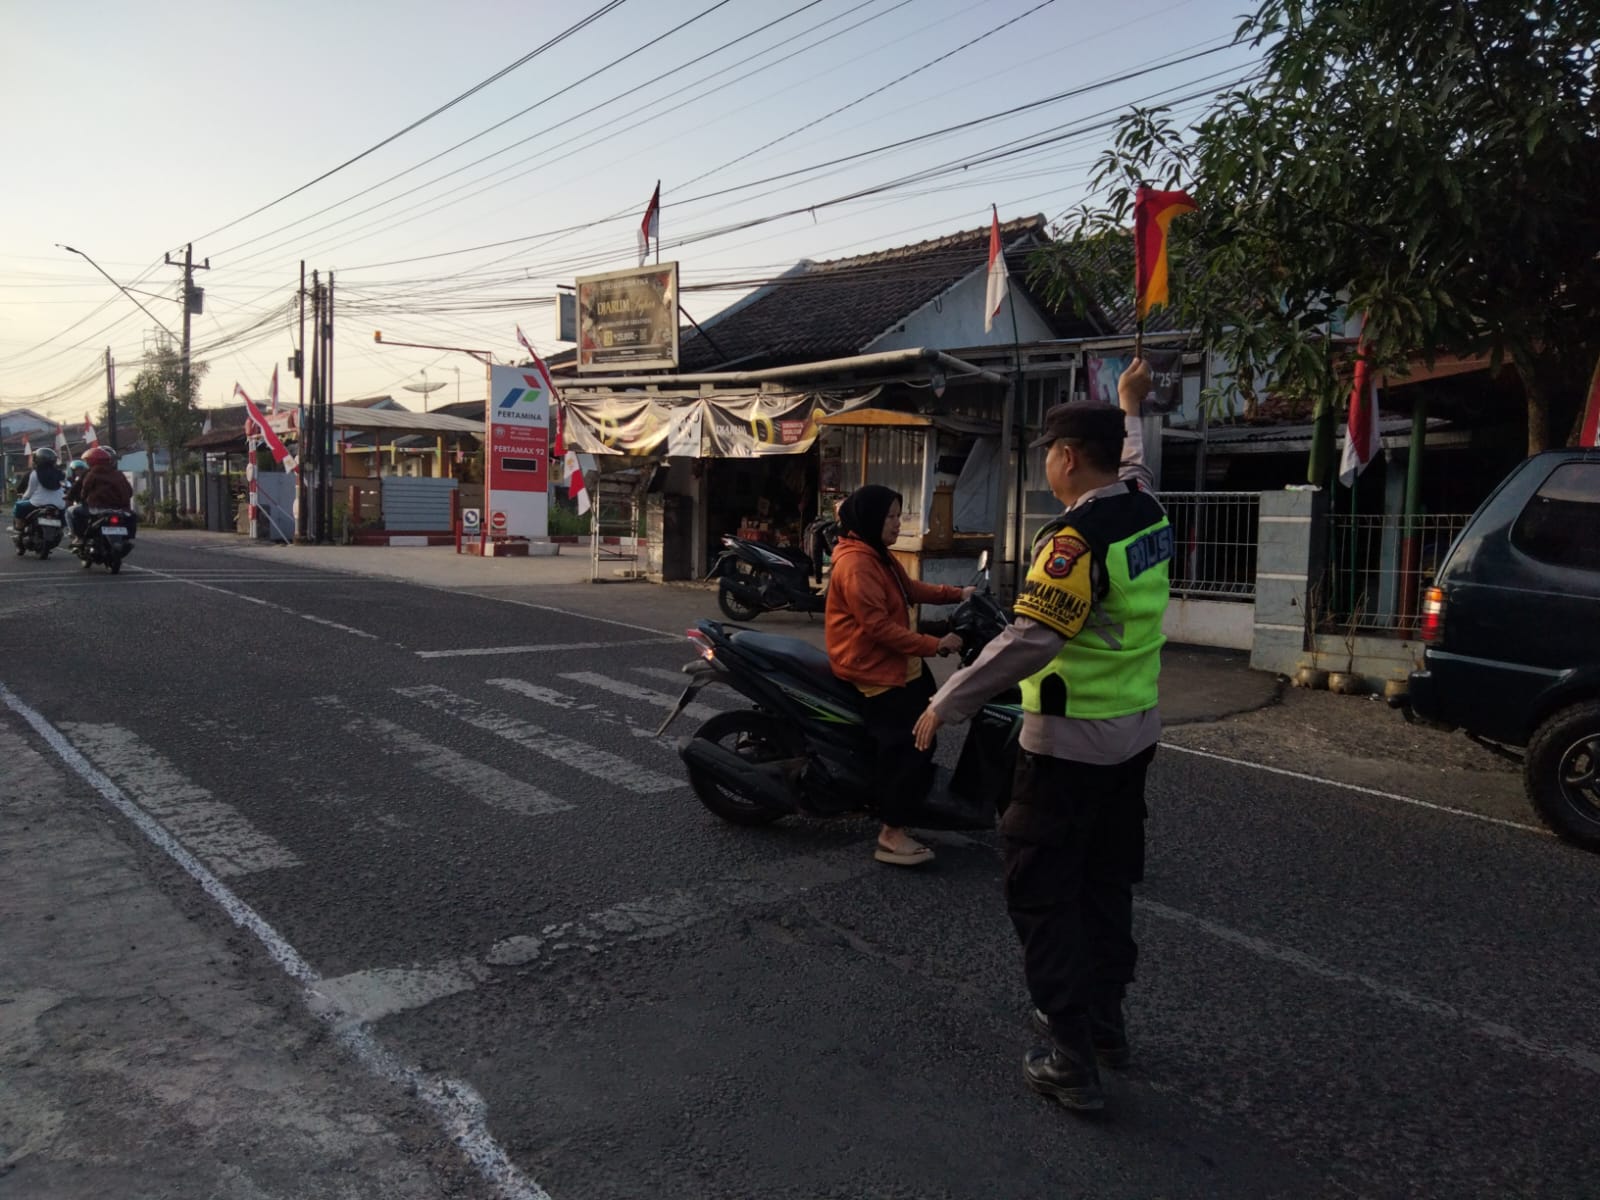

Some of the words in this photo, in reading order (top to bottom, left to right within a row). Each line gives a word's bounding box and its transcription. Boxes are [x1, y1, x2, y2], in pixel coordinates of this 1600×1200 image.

[1160, 372, 1171, 388] 25
[497, 410, 542, 421] PERTAMINA
[494, 445, 534, 455] PERTAMAX
[535, 448, 545, 456] 92
